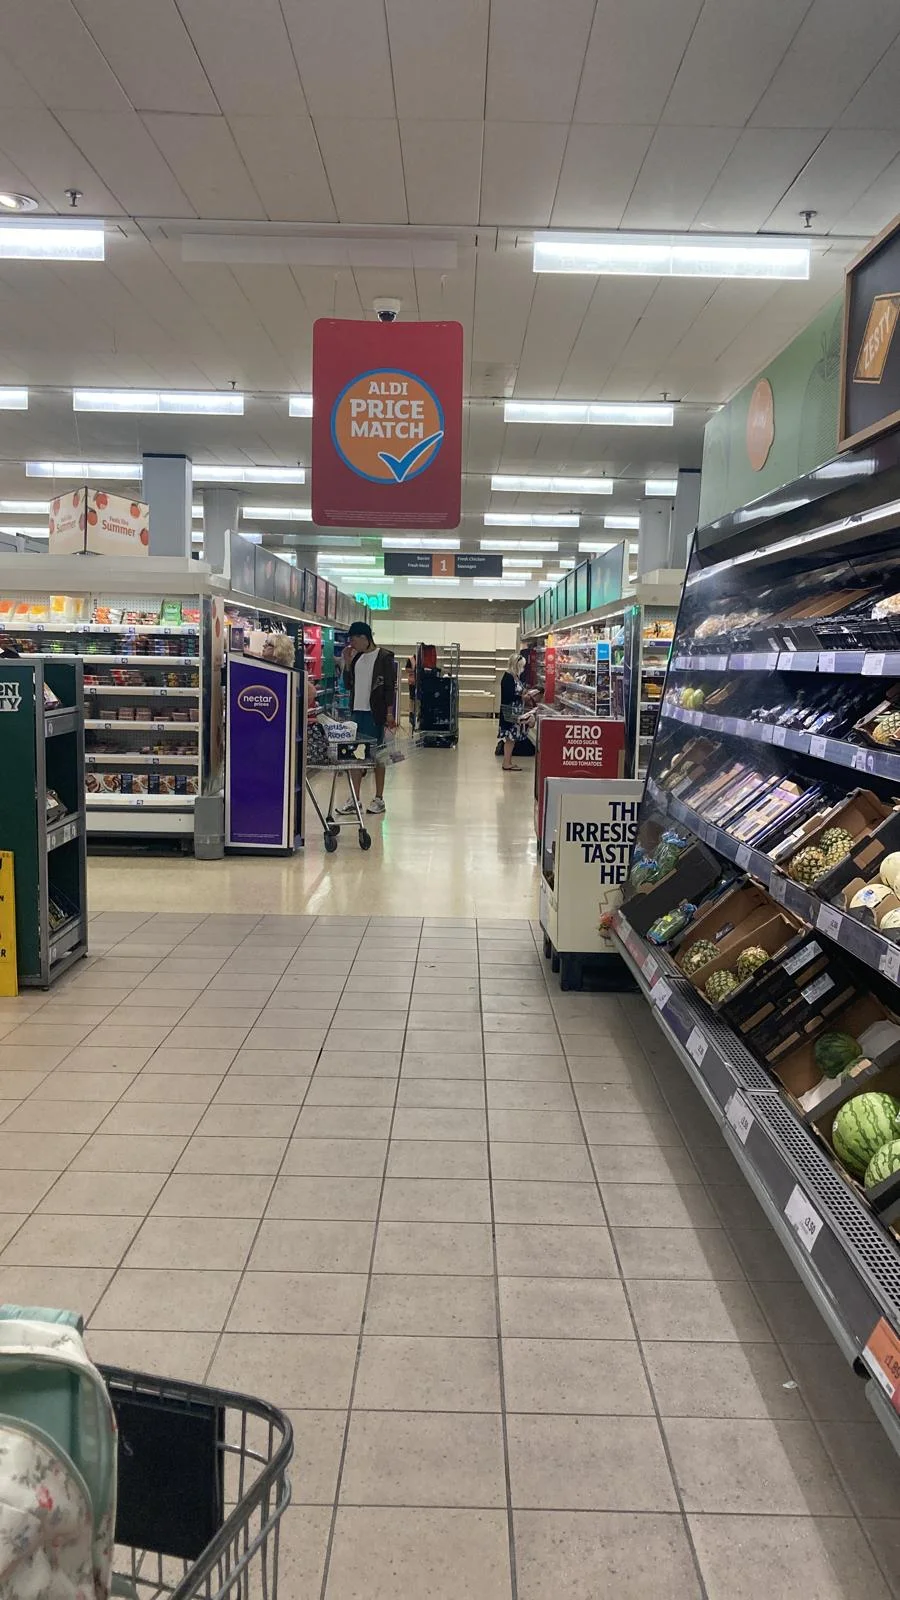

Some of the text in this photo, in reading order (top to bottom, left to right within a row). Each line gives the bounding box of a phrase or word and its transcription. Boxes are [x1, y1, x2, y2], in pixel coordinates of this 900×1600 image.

[864, 306, 890, 369] ZESTY
[368, 381, 409, 396] ALDI
[350, 398, 425, 419] PRICE
[351, 420, 424, 439] MATCH
[102, 519, 136, 537] Summer
[440, 559, 448, 572] 1
[243, 695, 272, 703] nectar
[564, 724, 602, 740] ZERO
[562, 746, 603, 761] MORE
[600, 864, 631, 885] HE
